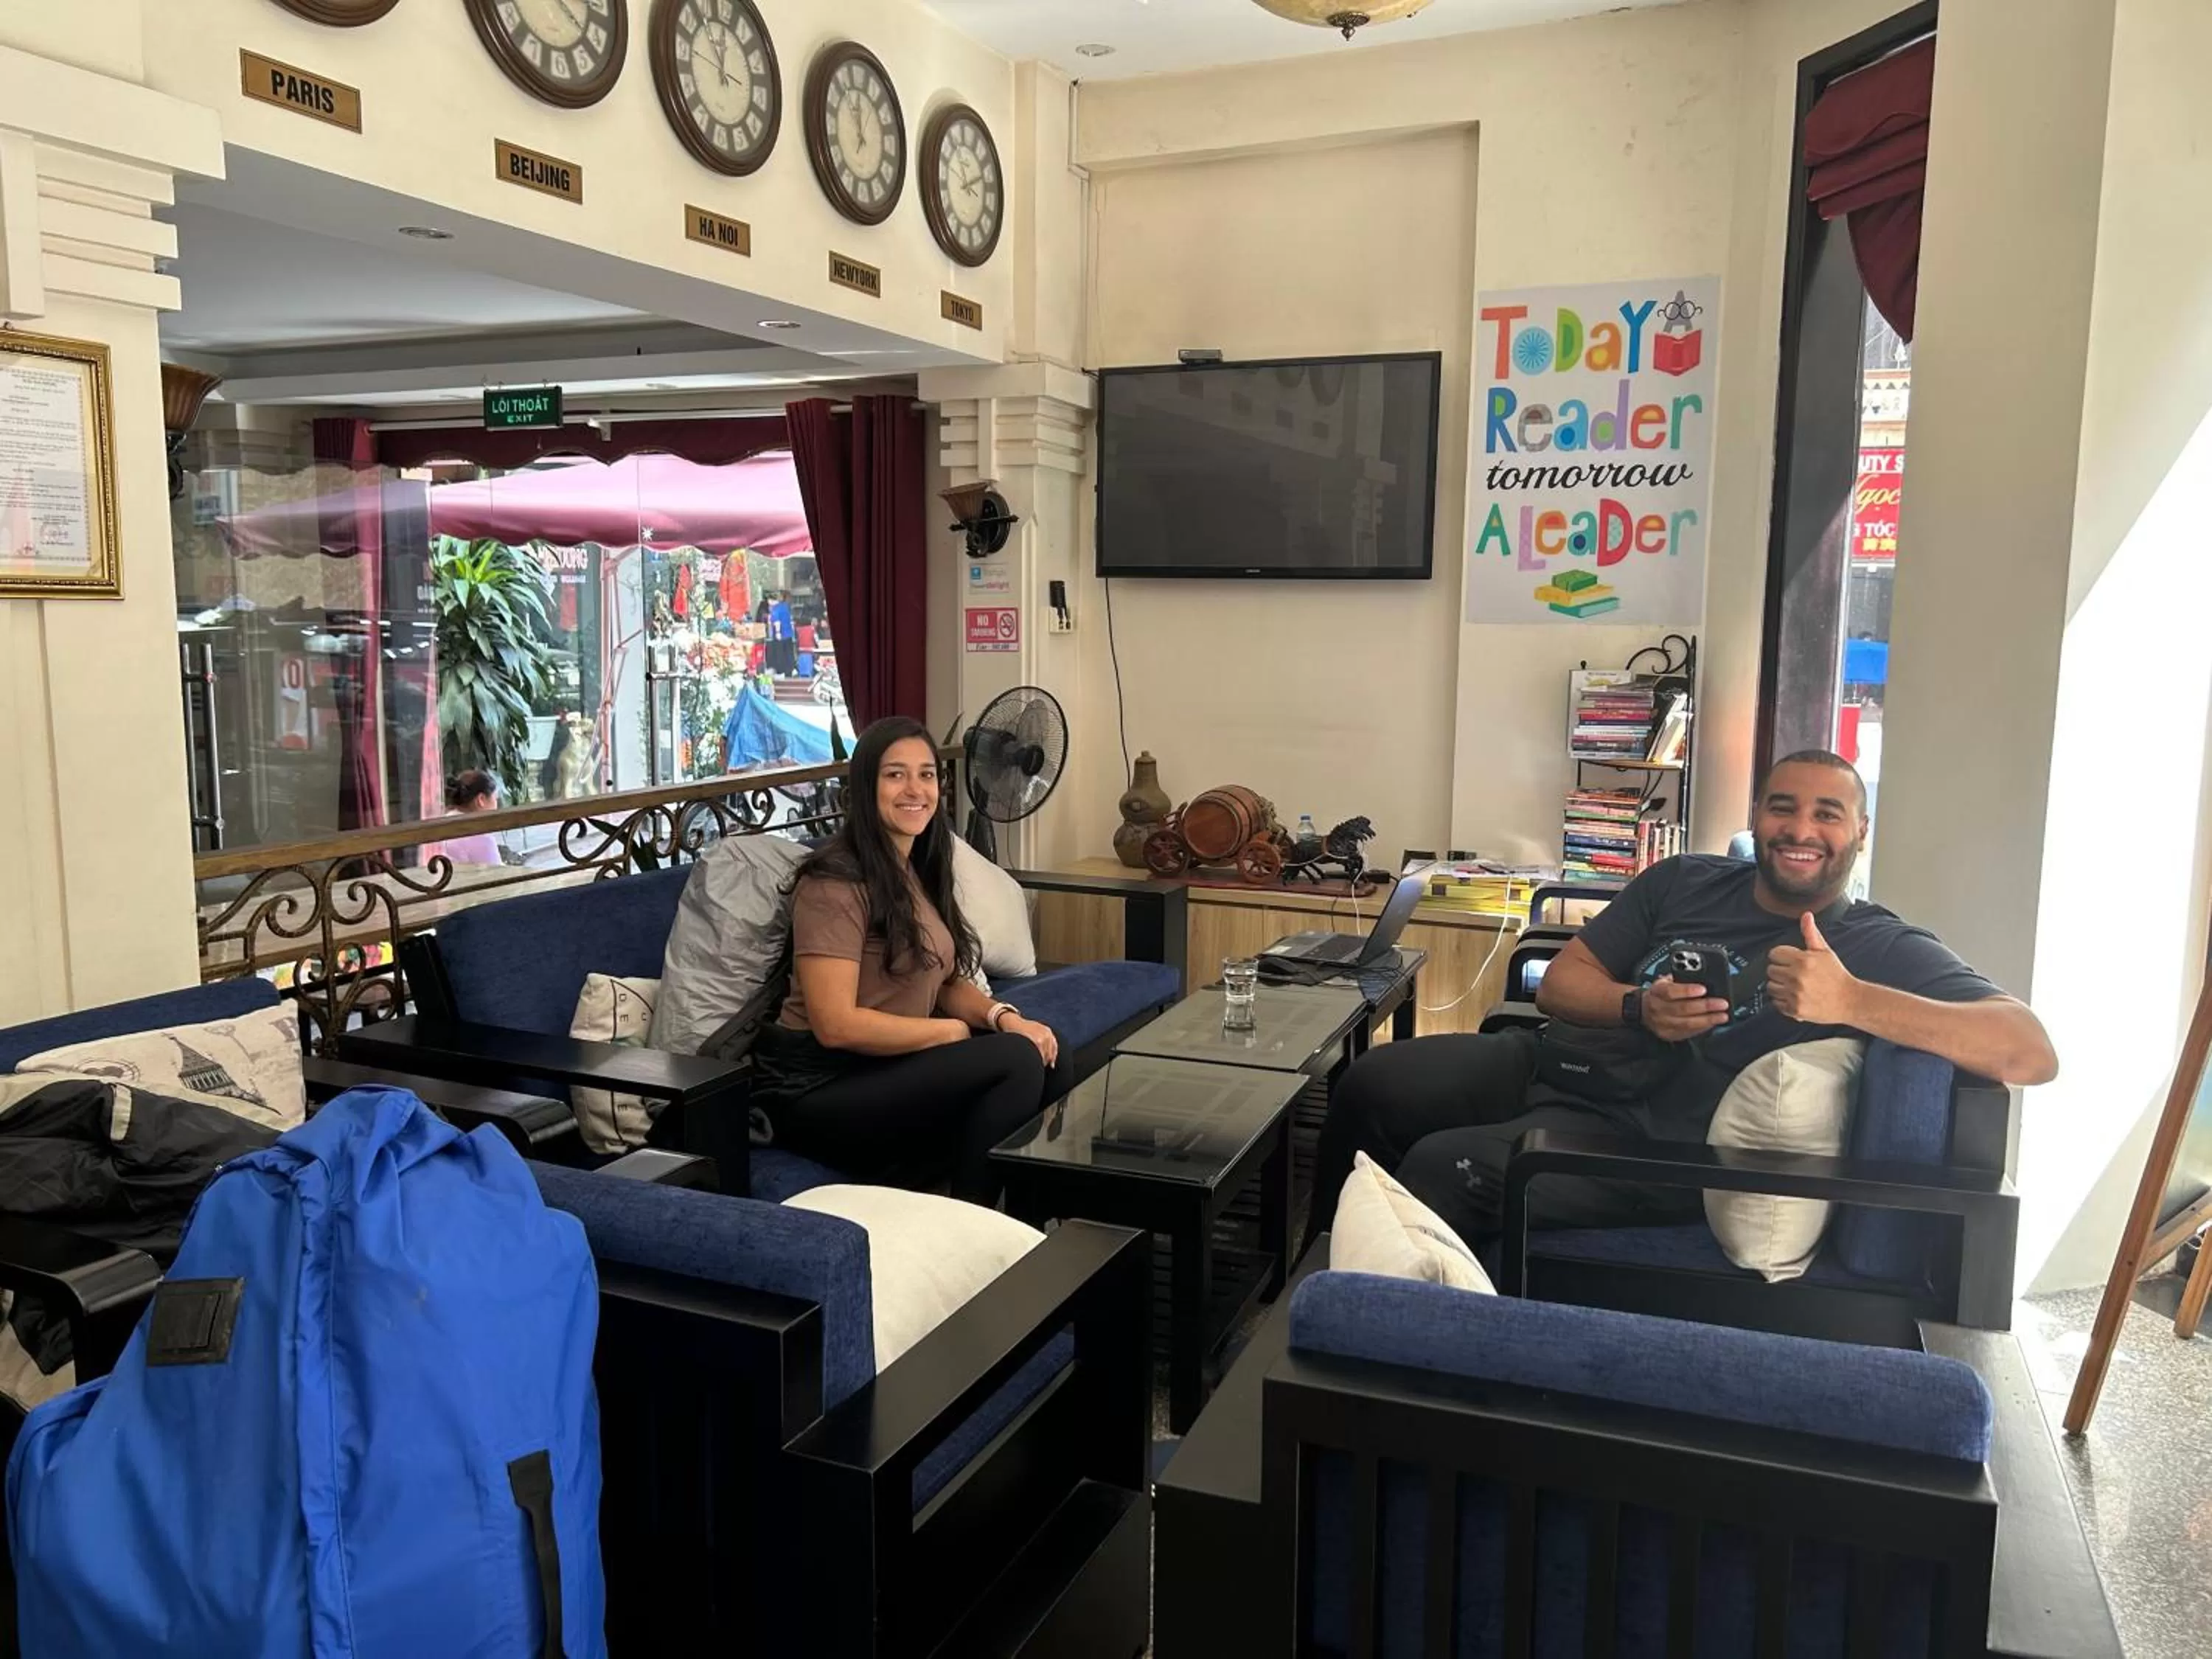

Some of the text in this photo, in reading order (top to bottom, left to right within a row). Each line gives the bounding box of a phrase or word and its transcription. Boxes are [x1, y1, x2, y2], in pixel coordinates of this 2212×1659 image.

[554, 54, 566, 75] 6
[271, 69, 334, 114] PARIS
[509, 153, 570, 192] BEIJING
[699, 216, 738, 246] HA NOI
[834, 259, 877, 291] NEWYORK
[950, 300, 974, 322] TOKYO
[507, 414, 534, 424] EXIT
[1486, 378, 1703, 453] Reader
[1486, 459, 1694, 491] tomorrow
[1475, 503, 1511, 556] A
[976, 613, 989, 626] NO
